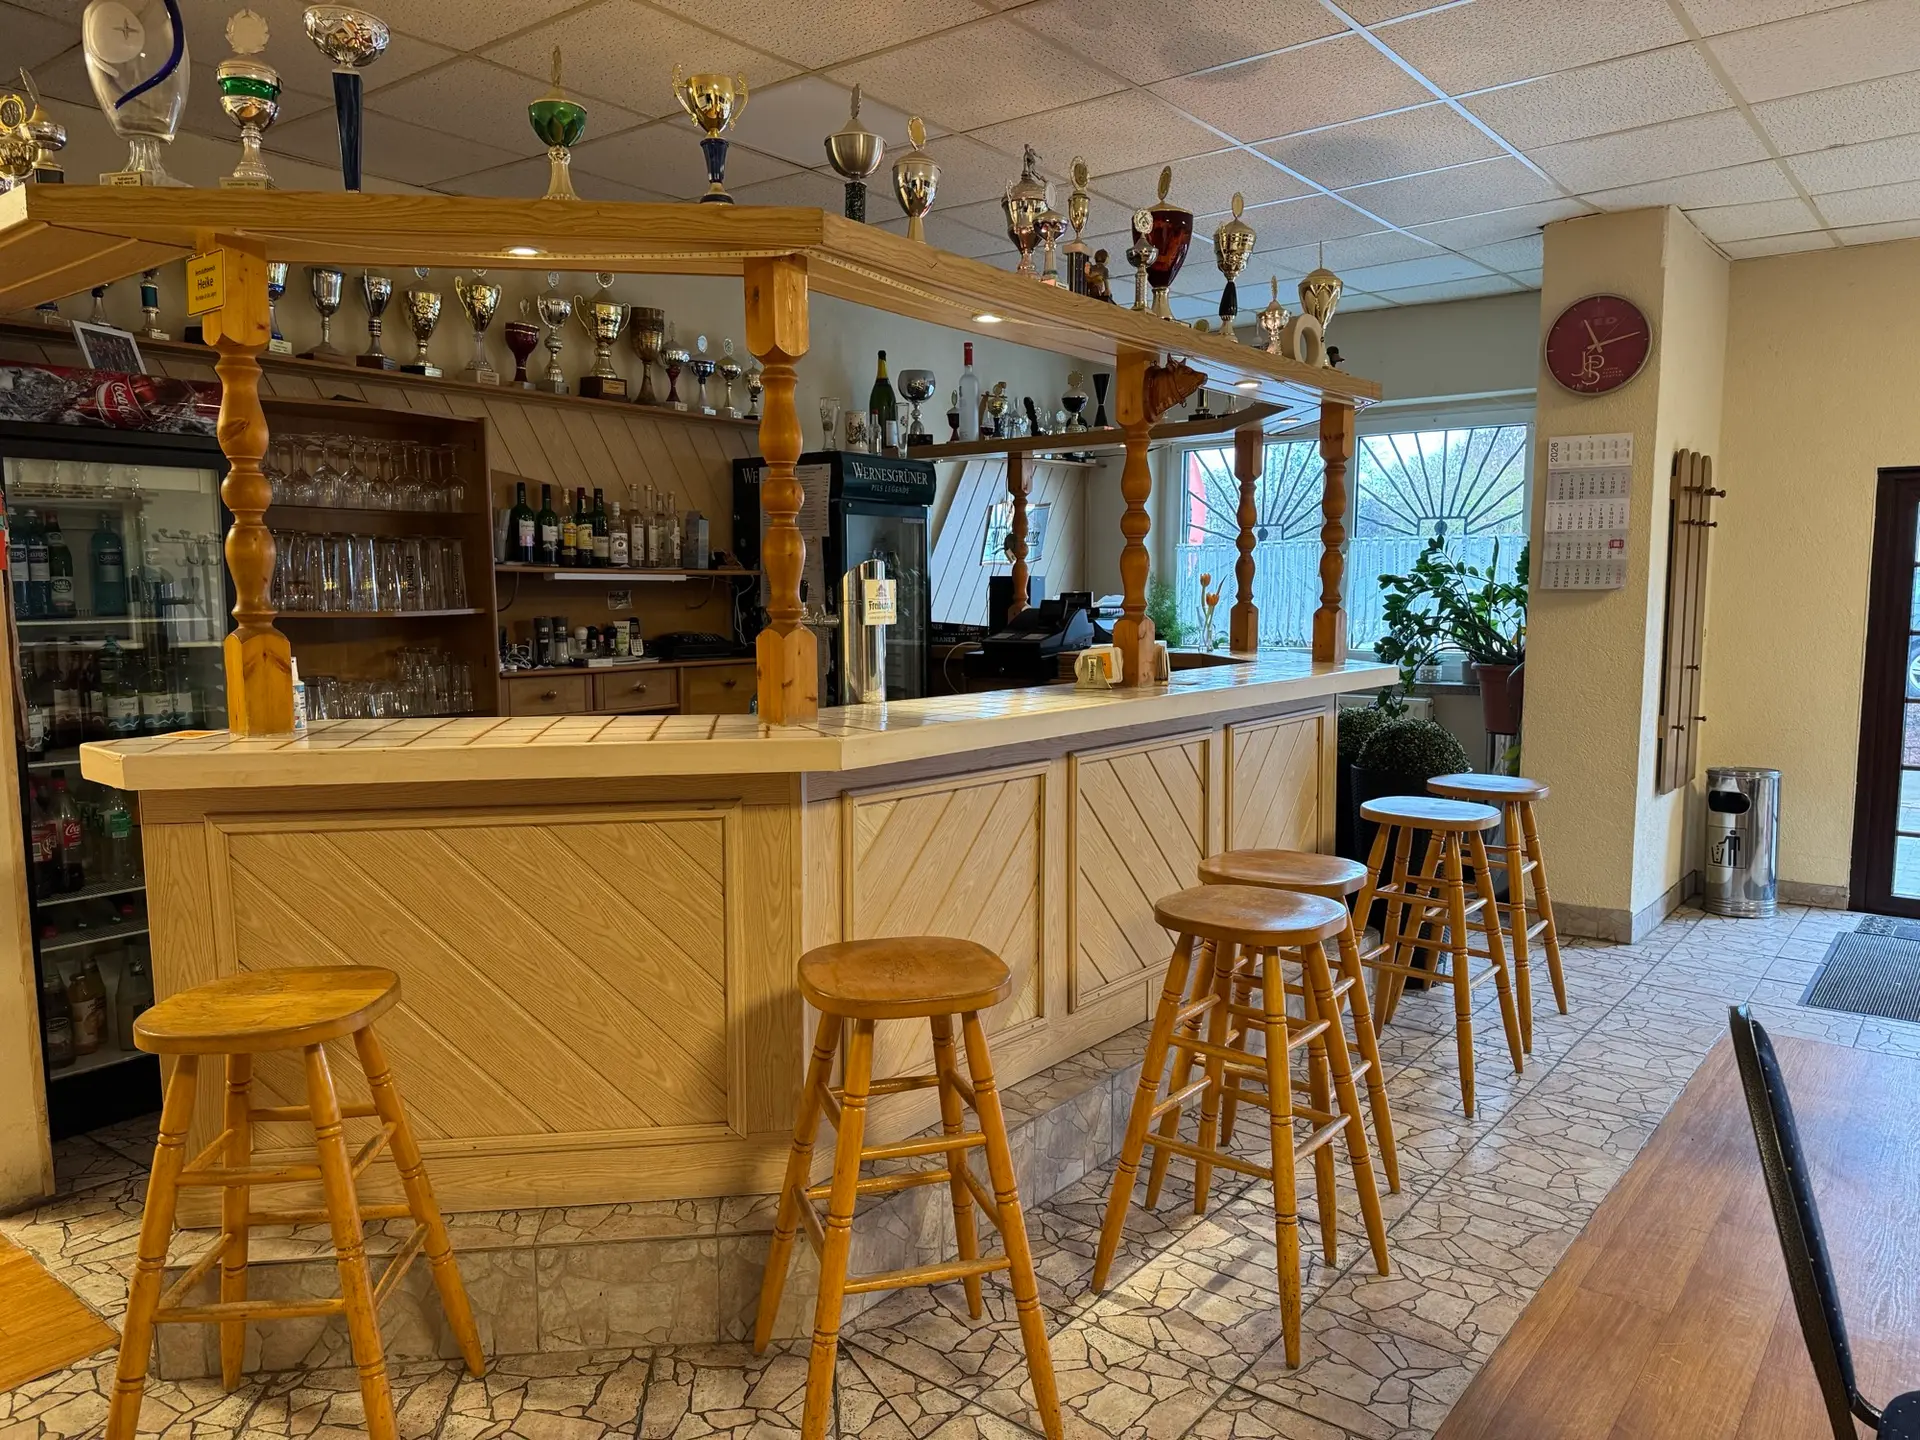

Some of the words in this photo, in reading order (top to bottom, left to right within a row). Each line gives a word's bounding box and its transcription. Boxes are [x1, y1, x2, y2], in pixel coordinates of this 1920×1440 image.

[197, 277, 214, 290] Heike
[1550, 442, 1559, 463] 2026
[852, 461, 929, 485] WERNESGRÜNER
